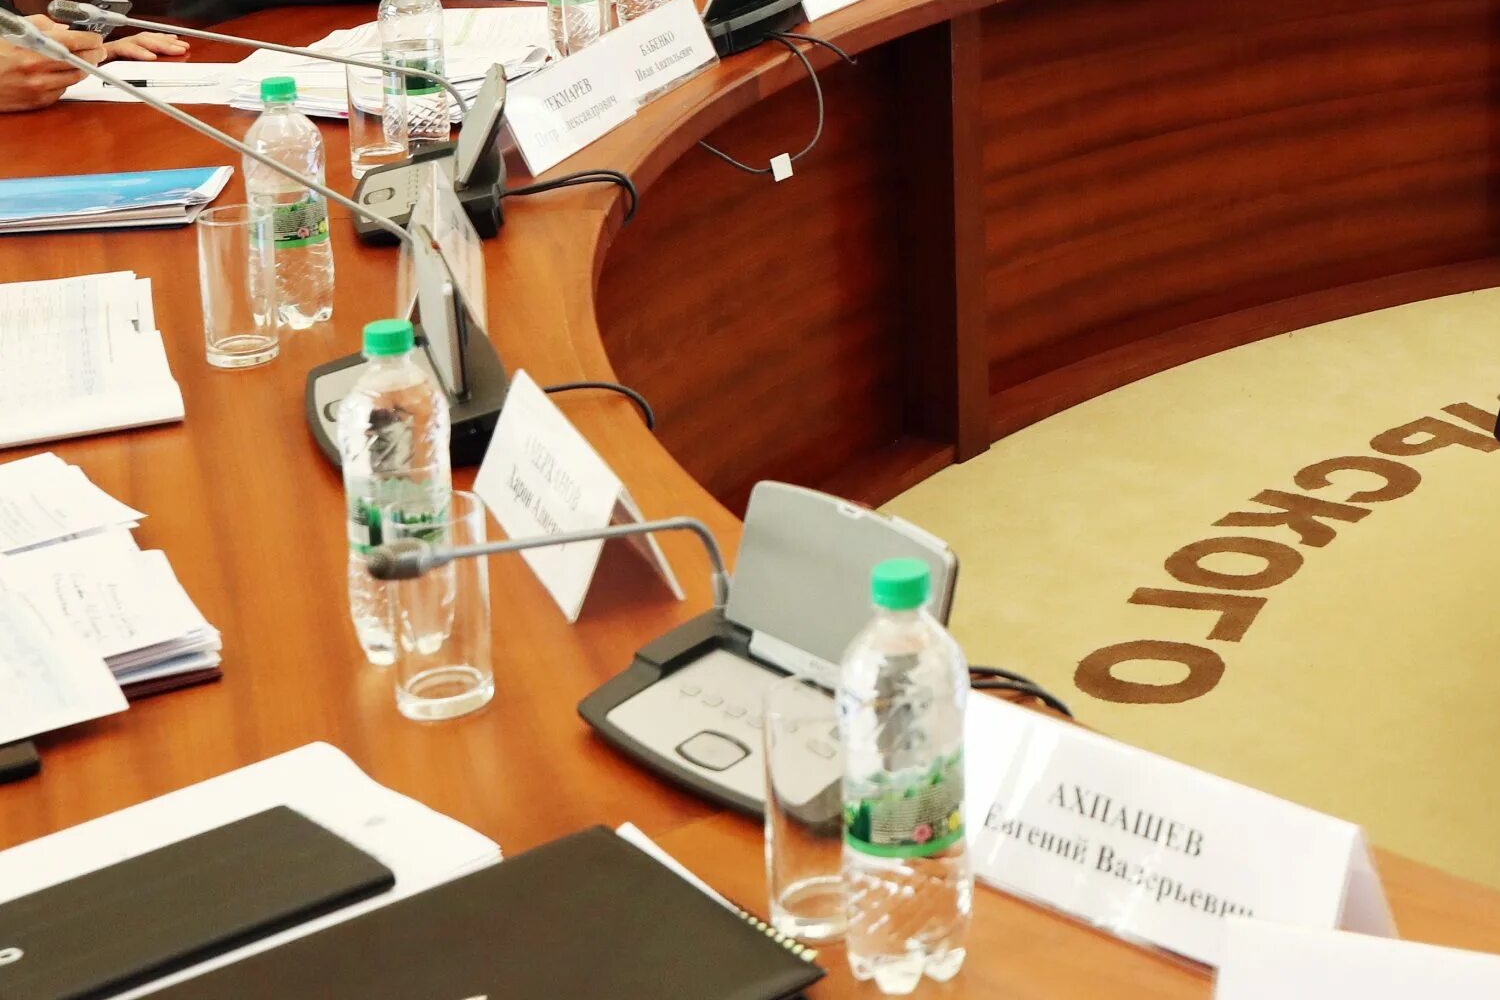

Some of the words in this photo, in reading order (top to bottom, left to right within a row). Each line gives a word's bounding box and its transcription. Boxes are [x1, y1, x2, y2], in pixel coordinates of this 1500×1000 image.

[639, 30, 676, 57] БАБЕНКО
[543, 77, 593, 112] ЕКМАРЕВ
[982, 800, 1088, 865] Евгений
[1048, 780, 1205, 859] АХПАШЕВ
